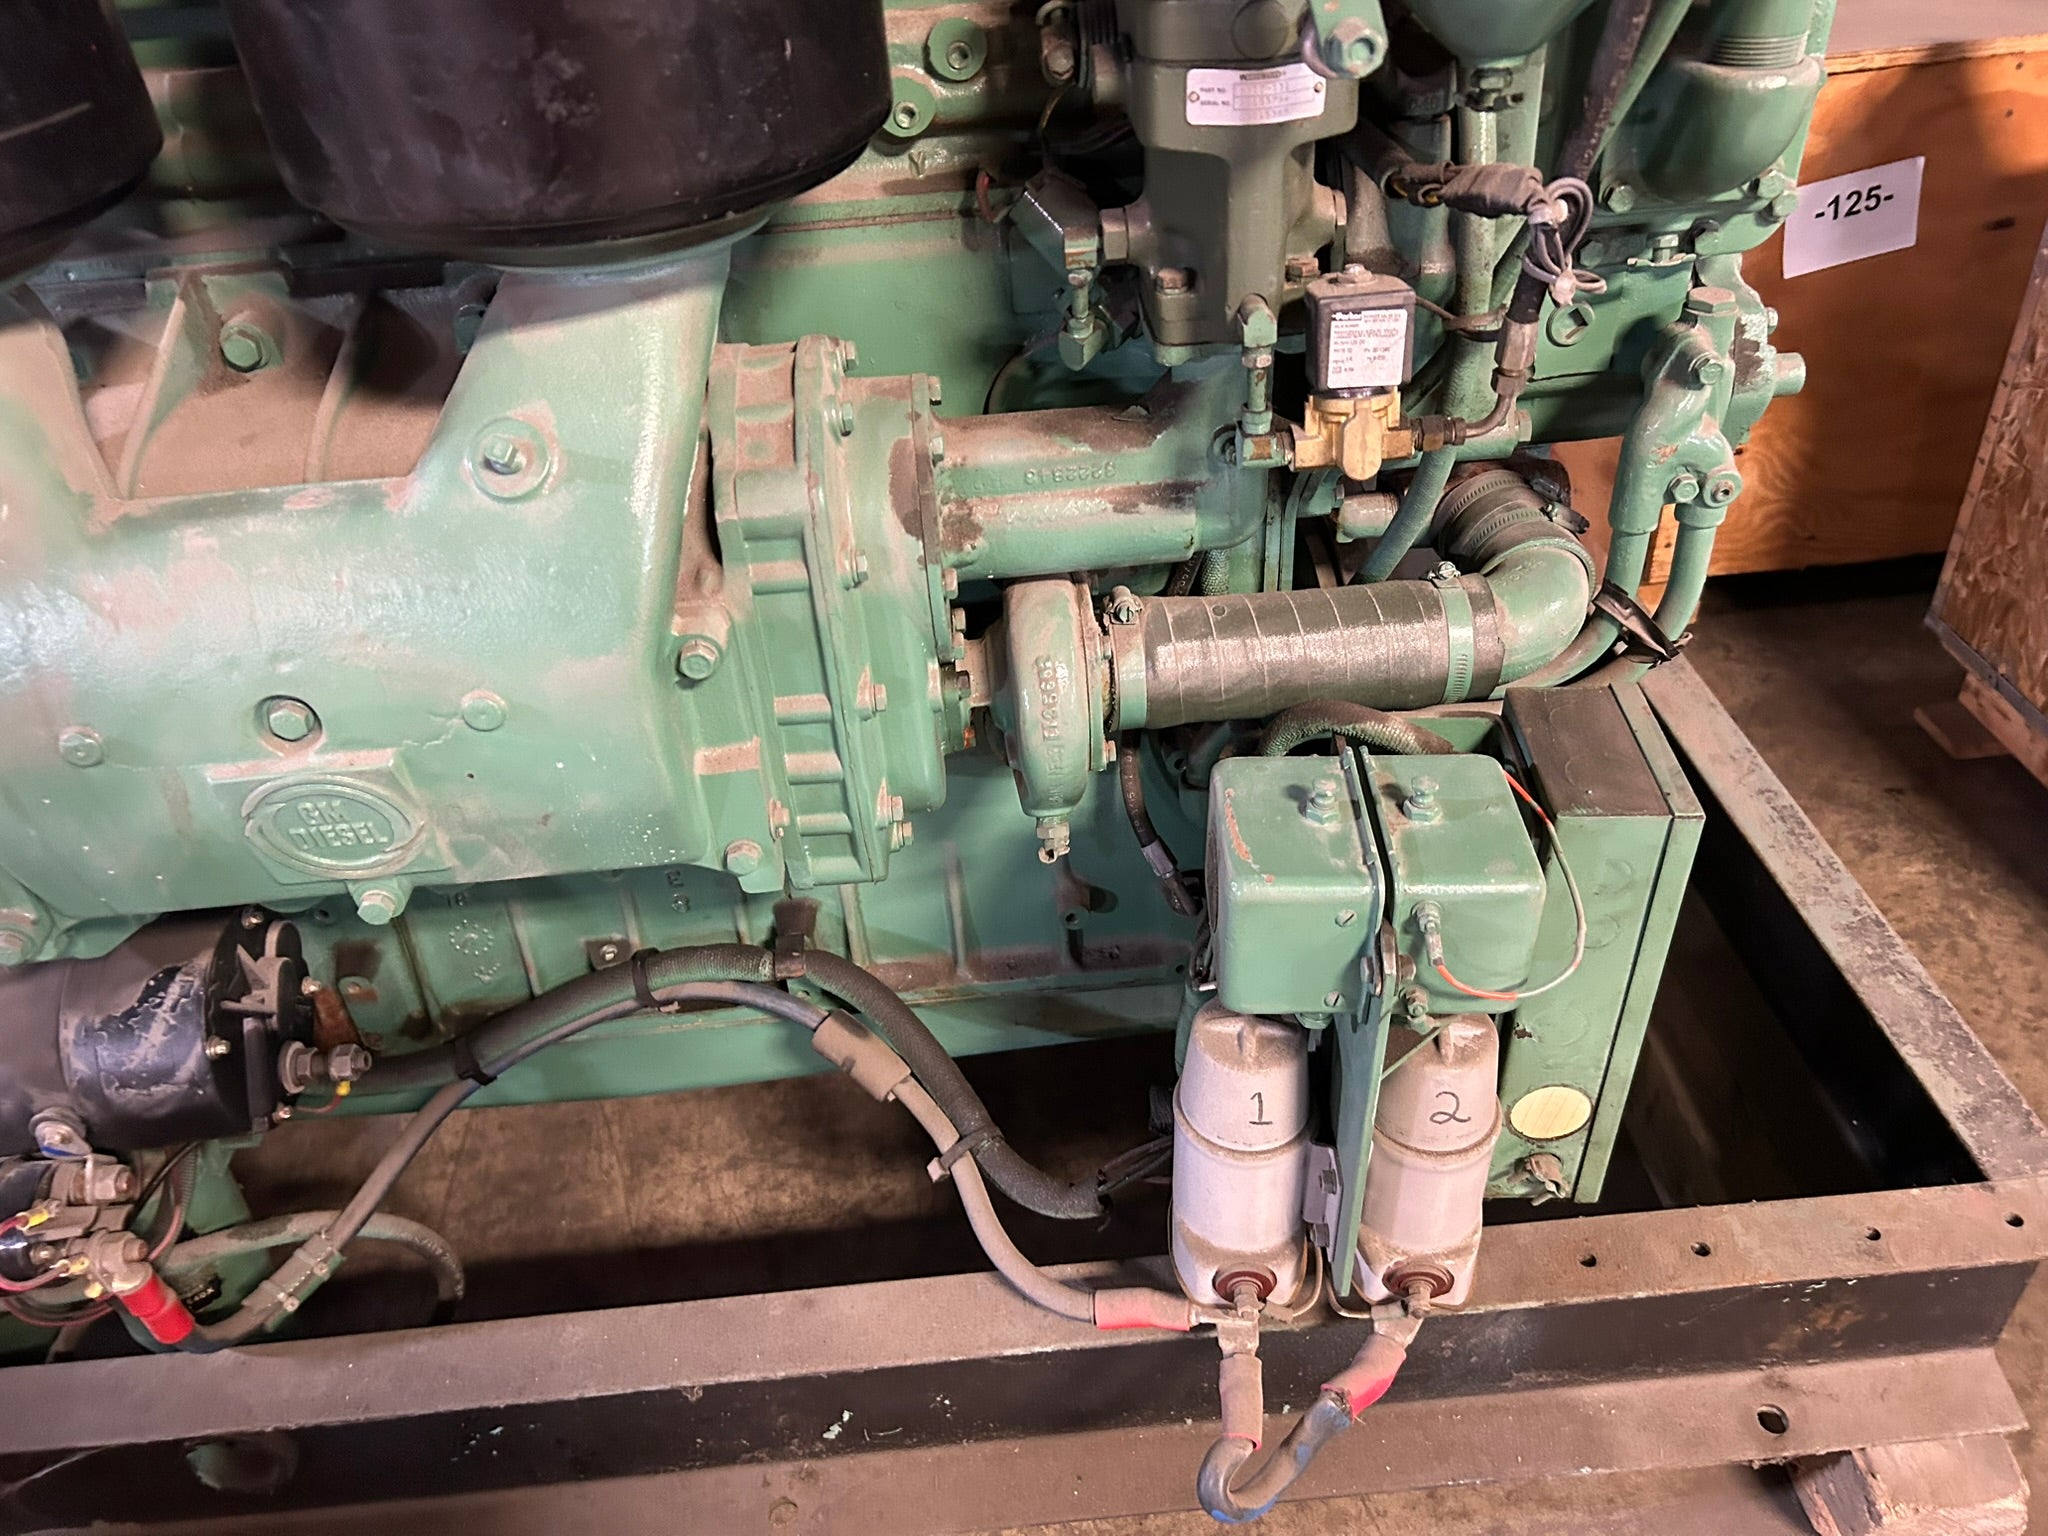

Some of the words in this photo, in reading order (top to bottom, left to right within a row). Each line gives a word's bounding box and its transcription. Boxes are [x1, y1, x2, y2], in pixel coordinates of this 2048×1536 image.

[1815, 184, 1894, 220] -125-
[297, 799, 351, 826] GM
[288, 821, 389, 851] DIESEL
[1248, 1091, 1274, 1126] 1
[1429, 1091, 1472, 1125] 2
